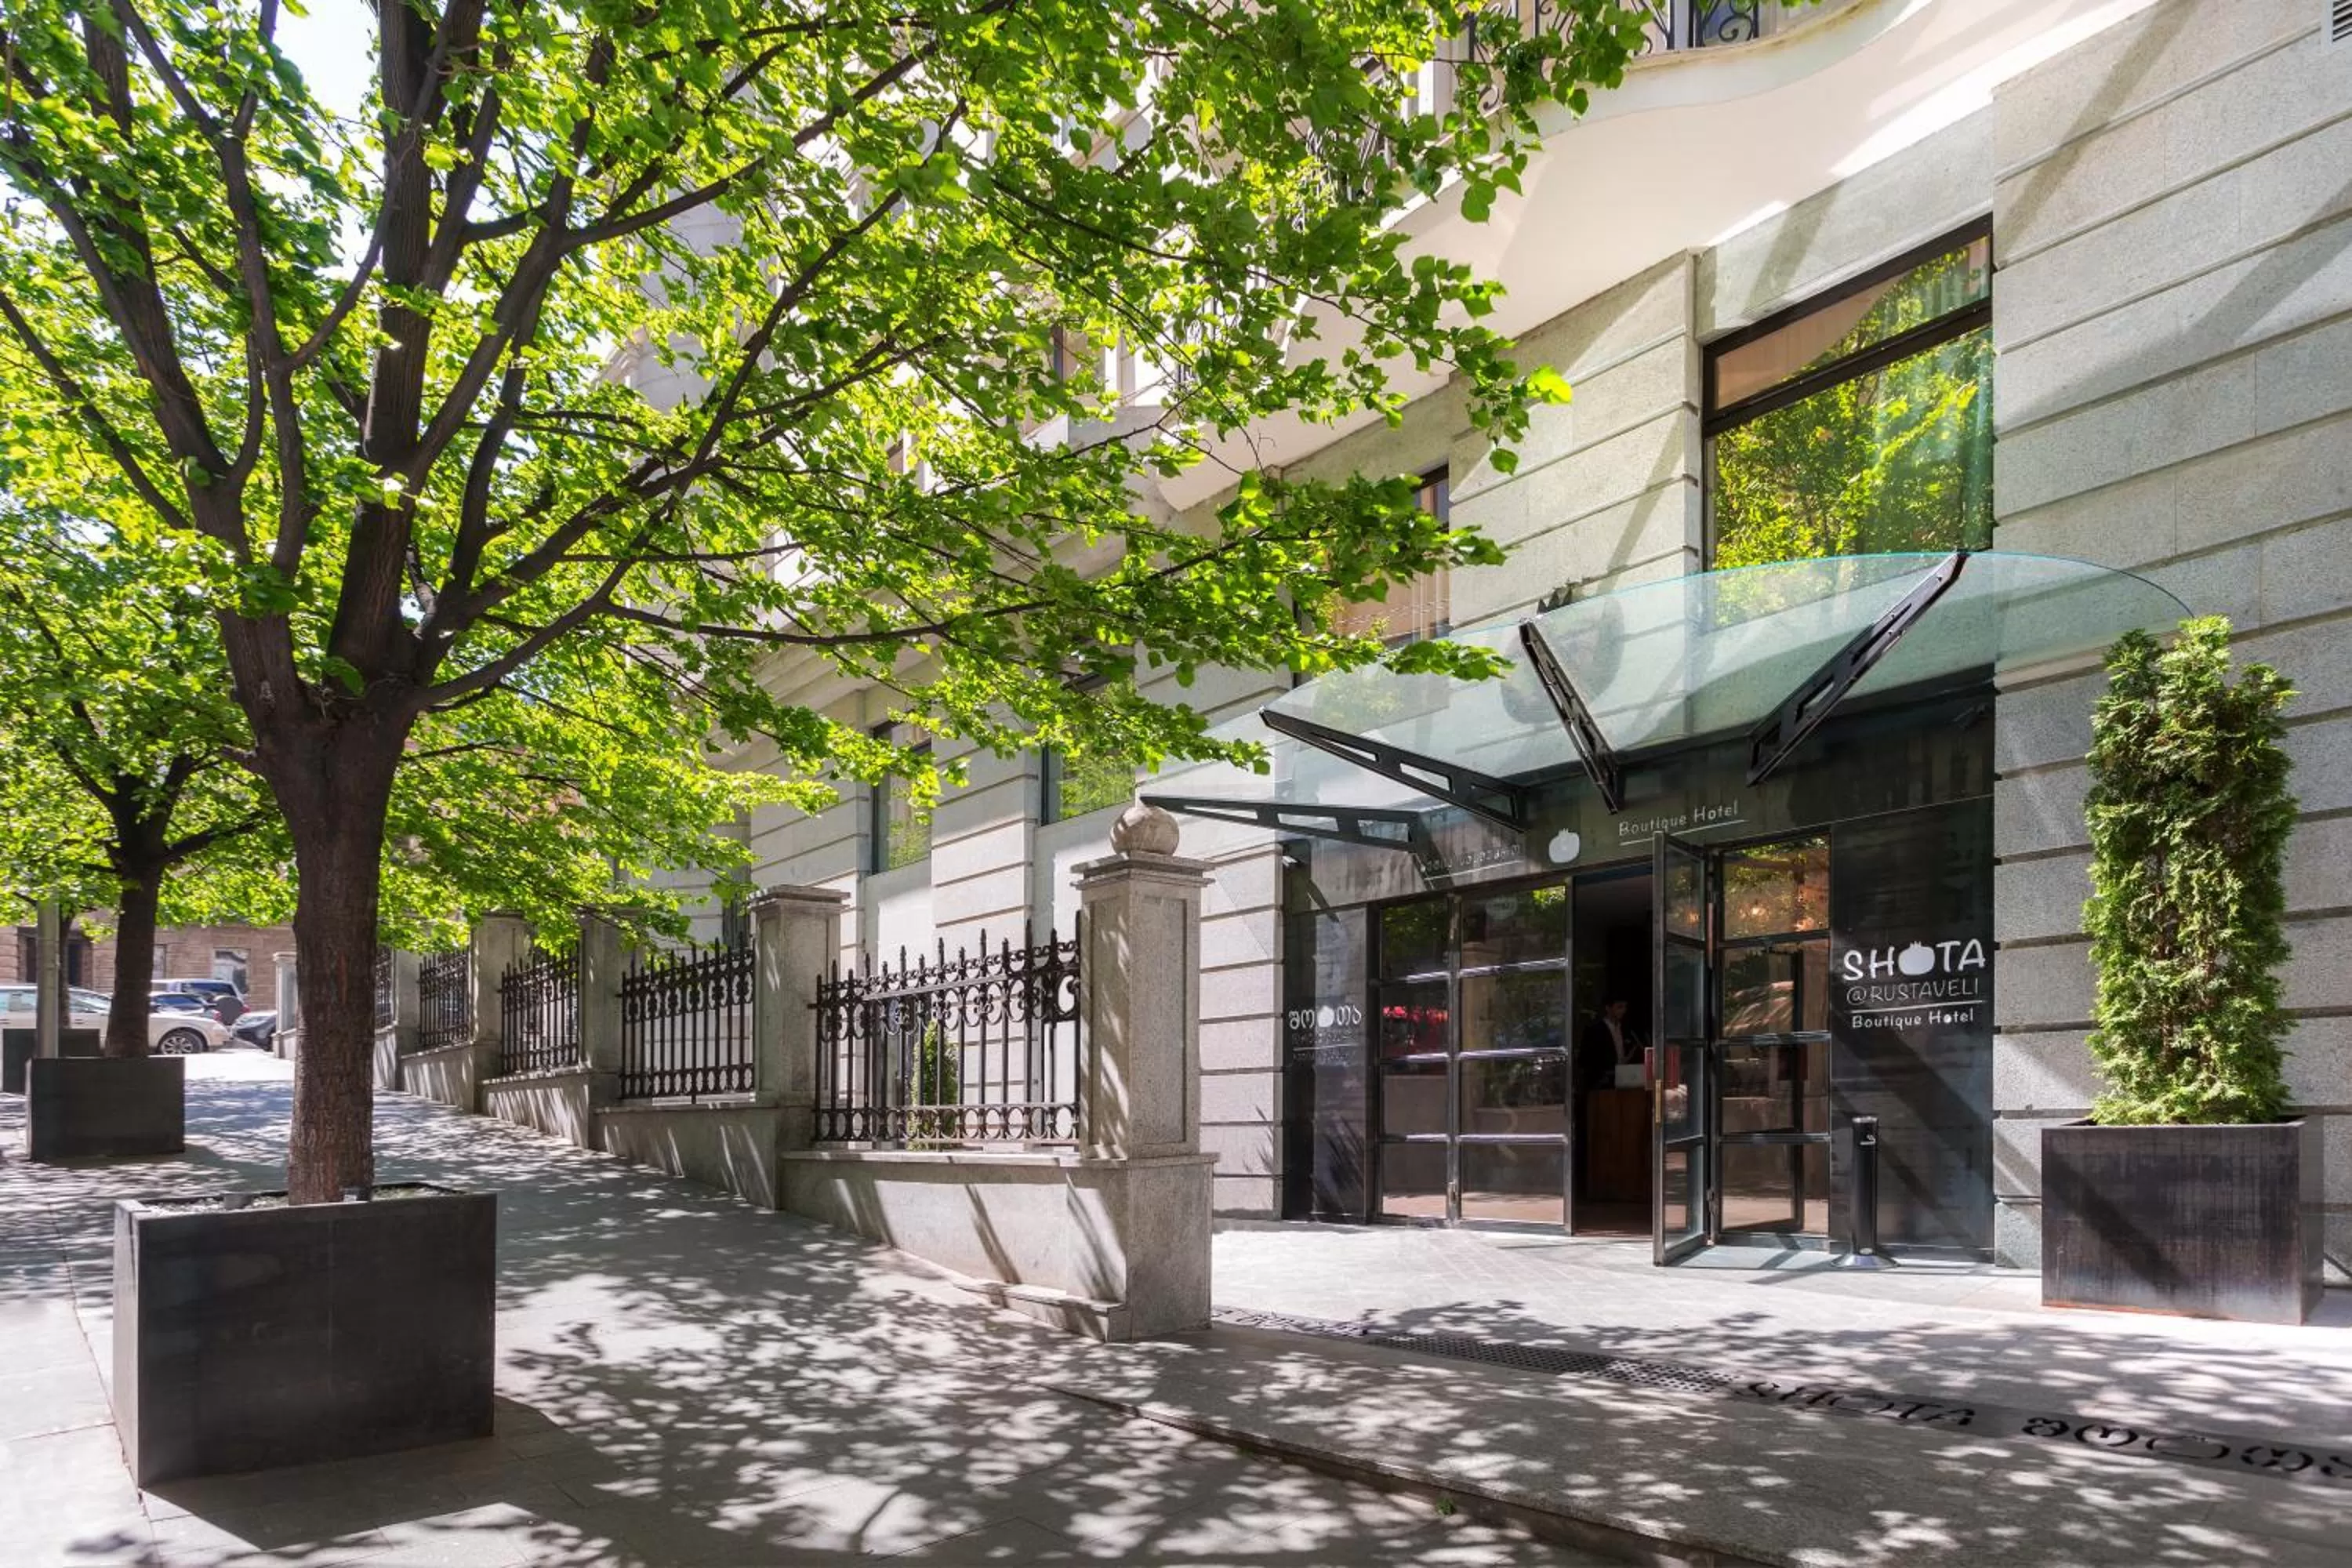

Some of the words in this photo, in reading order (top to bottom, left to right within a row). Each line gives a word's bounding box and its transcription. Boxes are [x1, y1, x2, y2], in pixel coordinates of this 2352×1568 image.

[1619, 815, 1687, 837] Boutique
[1694, 799, 1738, 822] Hotel
[1843, 938, 1985, 981] SHOTA
[1846, 978, 1978, 1005] @RUSTAVELI
[1852, 1014, 1922, 1031] Boutique
[1929, 1007, 1973, 1024] Hotel
